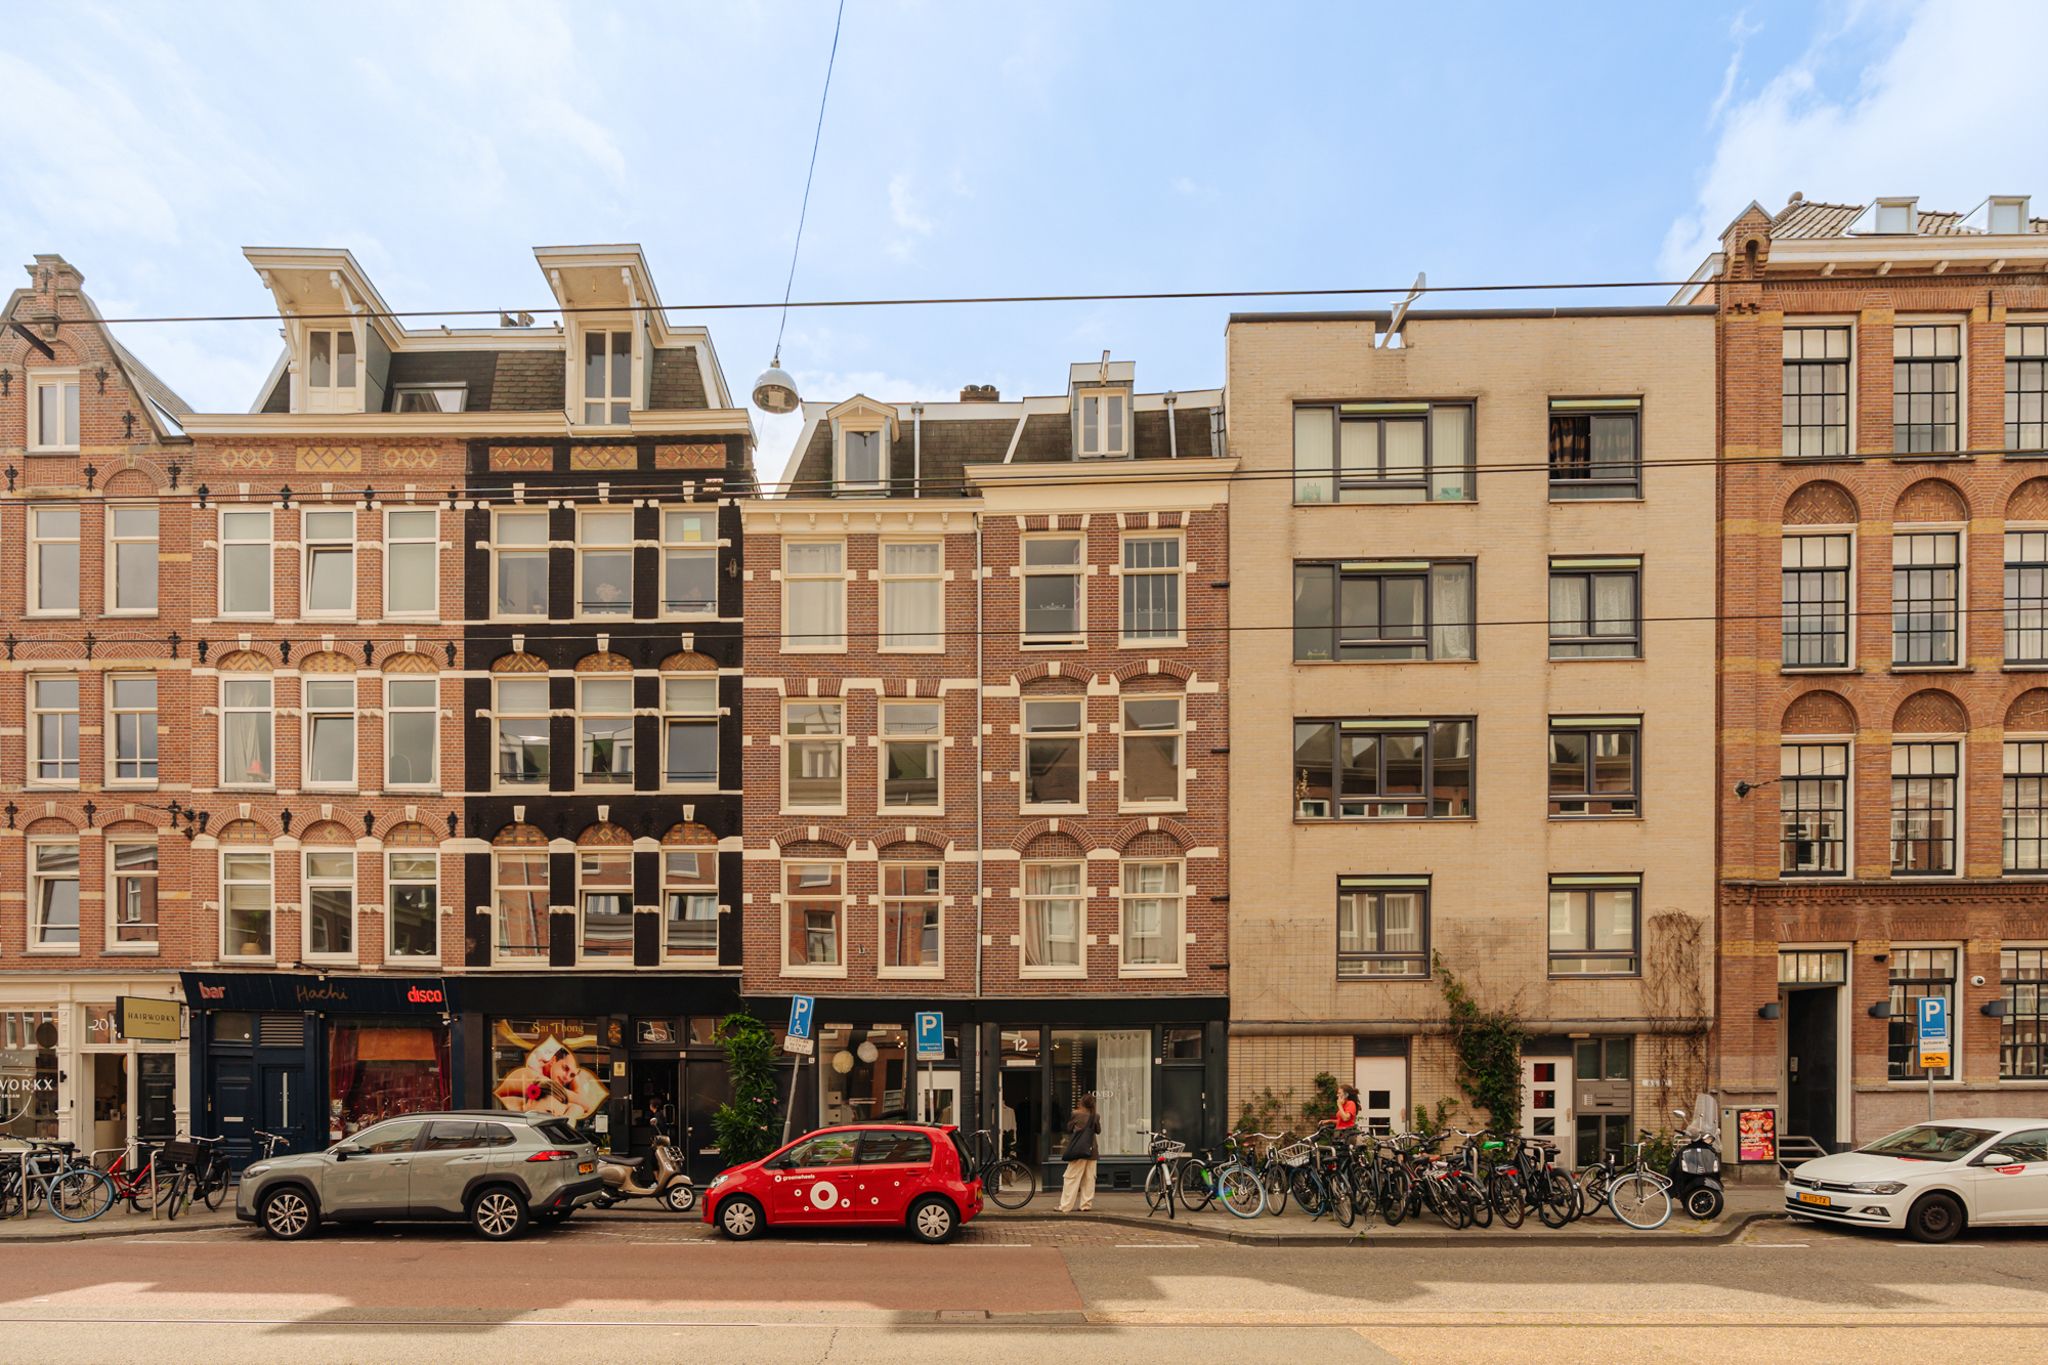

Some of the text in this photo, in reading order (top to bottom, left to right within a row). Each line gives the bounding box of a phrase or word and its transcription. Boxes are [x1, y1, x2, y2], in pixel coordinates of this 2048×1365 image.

[198, 981, 443, 1002] bar Hachi disco
[127, 1011, 176, 1023] HAIRWORKX
[795, 999, 809, 1019] P
[1925, 1001, 1941, 1022] P
[531, 1022, 584, 1034] Sai Thong
[922, 1015, 937, 1036] P
[1012, 1038, 1028, 1052] 12
